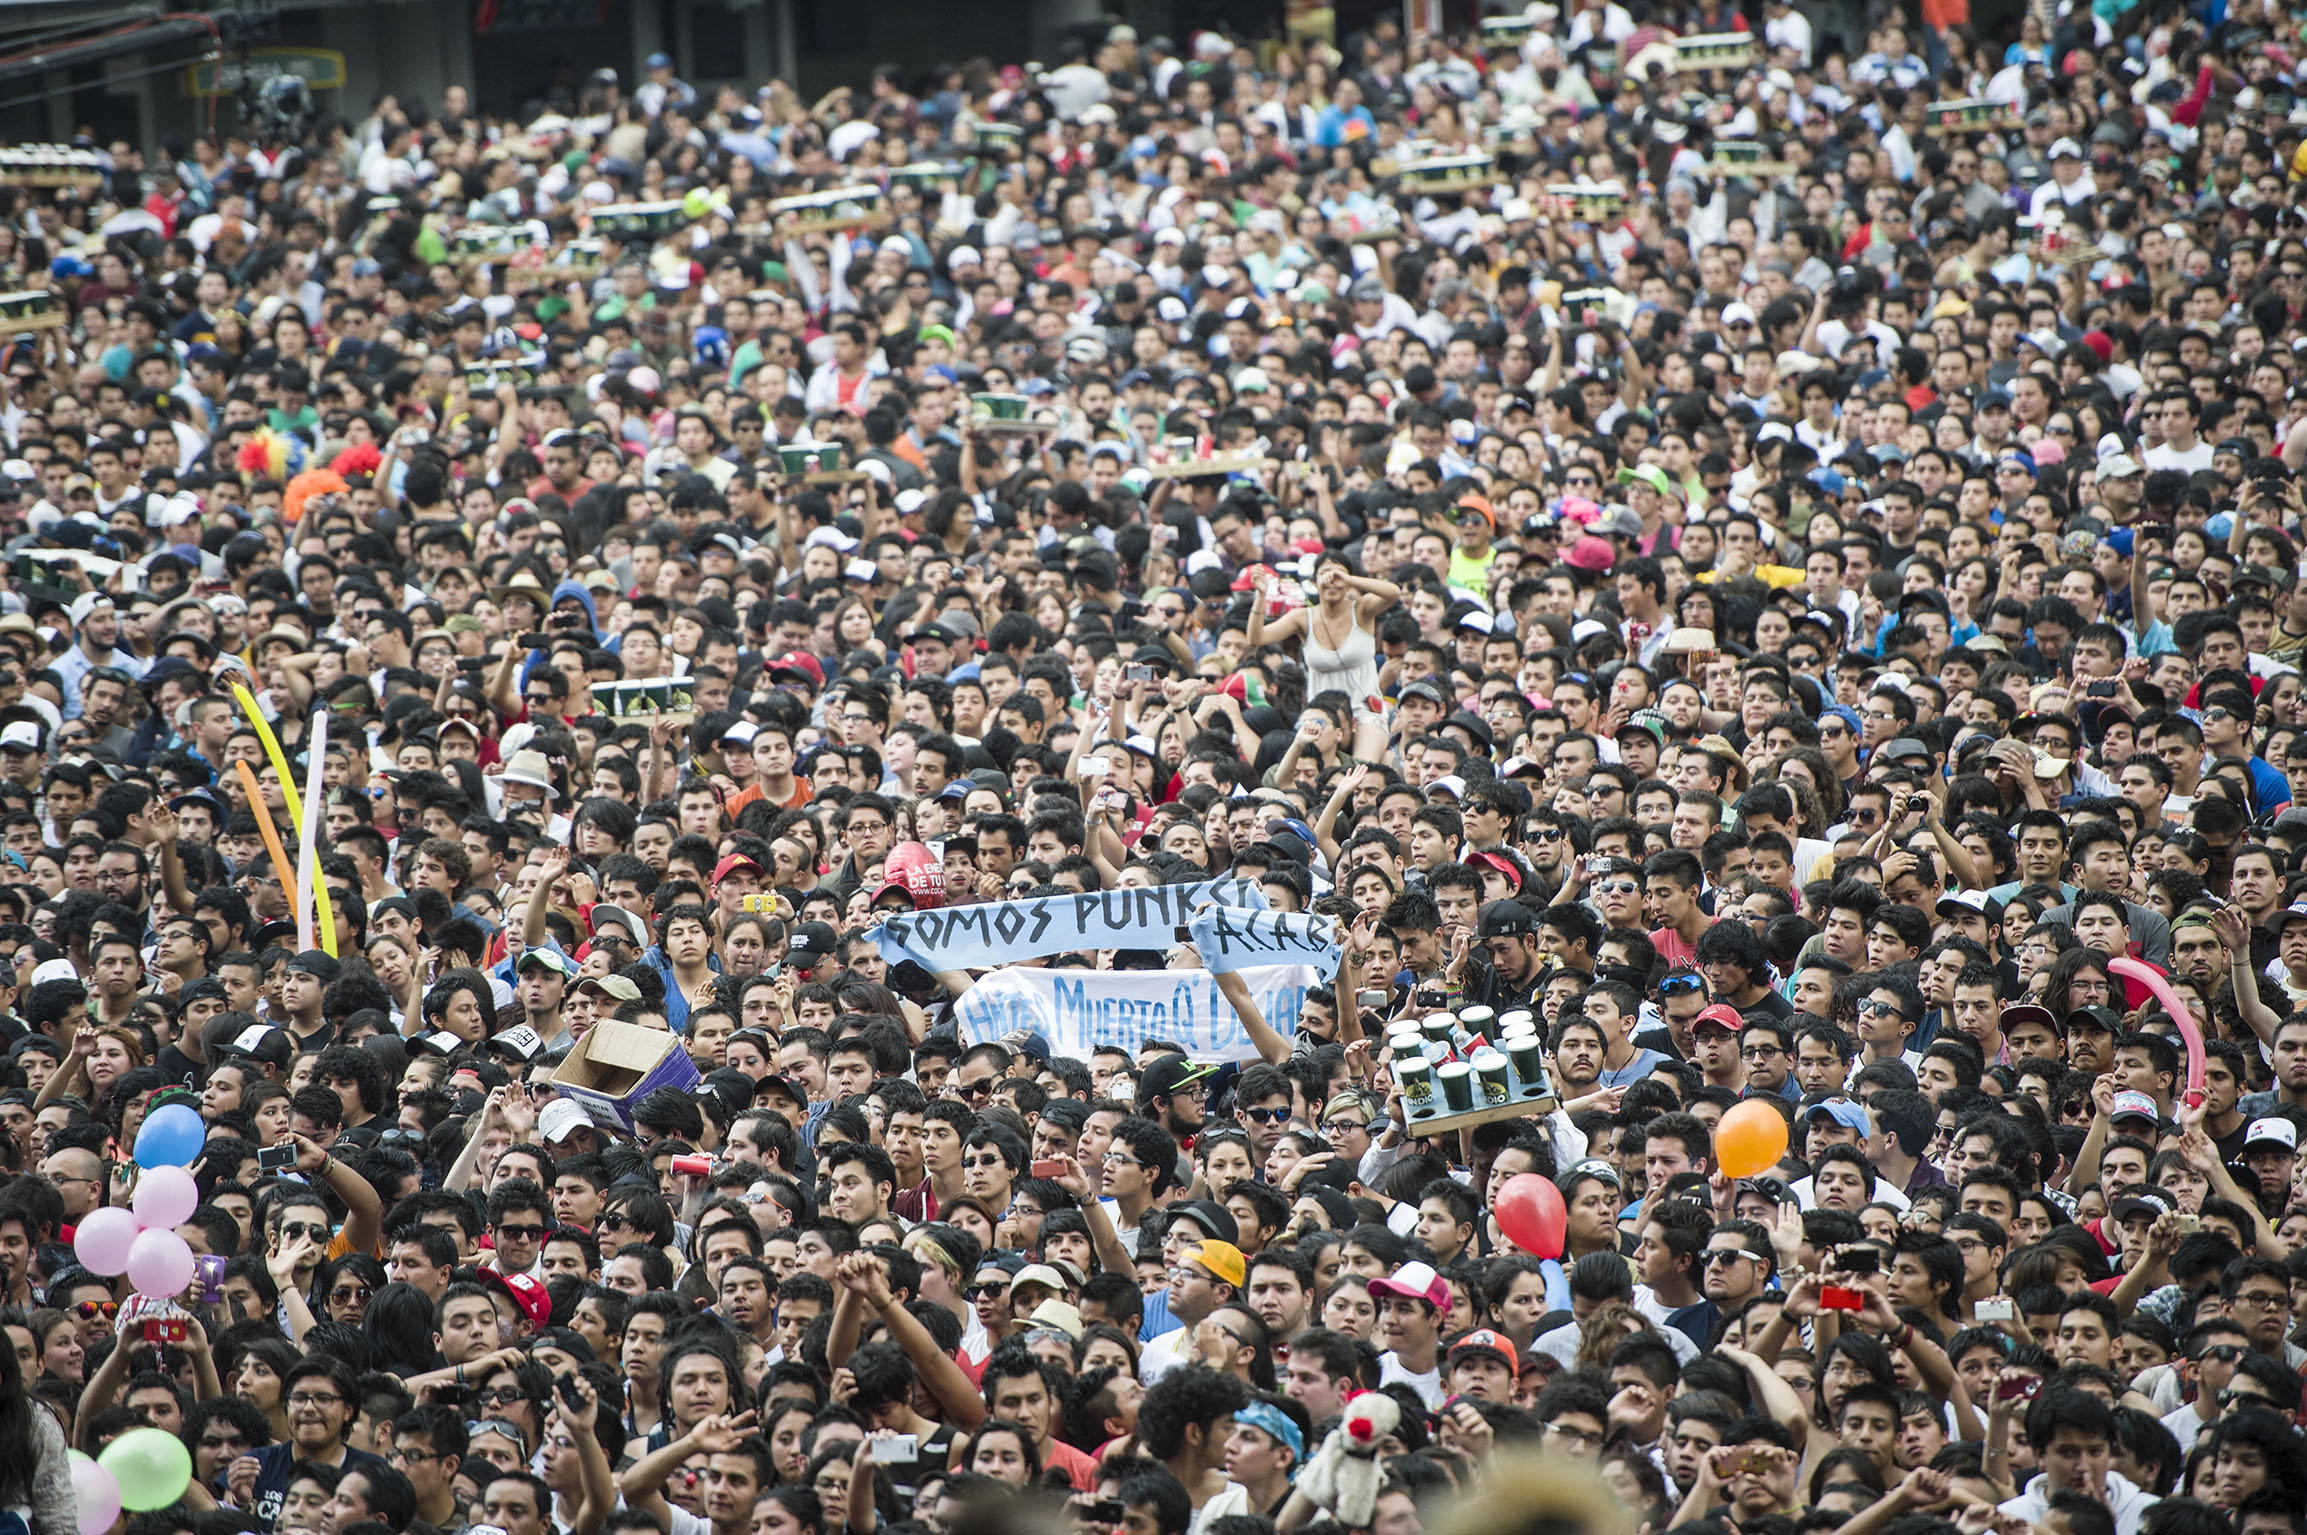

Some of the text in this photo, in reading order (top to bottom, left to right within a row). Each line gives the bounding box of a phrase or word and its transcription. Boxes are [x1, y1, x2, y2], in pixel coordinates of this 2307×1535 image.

[906, 865, 923, 876] LA
[909, 876, 928, 888] DE
[886, 899, 1052, 951] SOMOS
[1485, 1093, 1507, 1106] DIO
[264, 1490, 284, 1503] LOS
